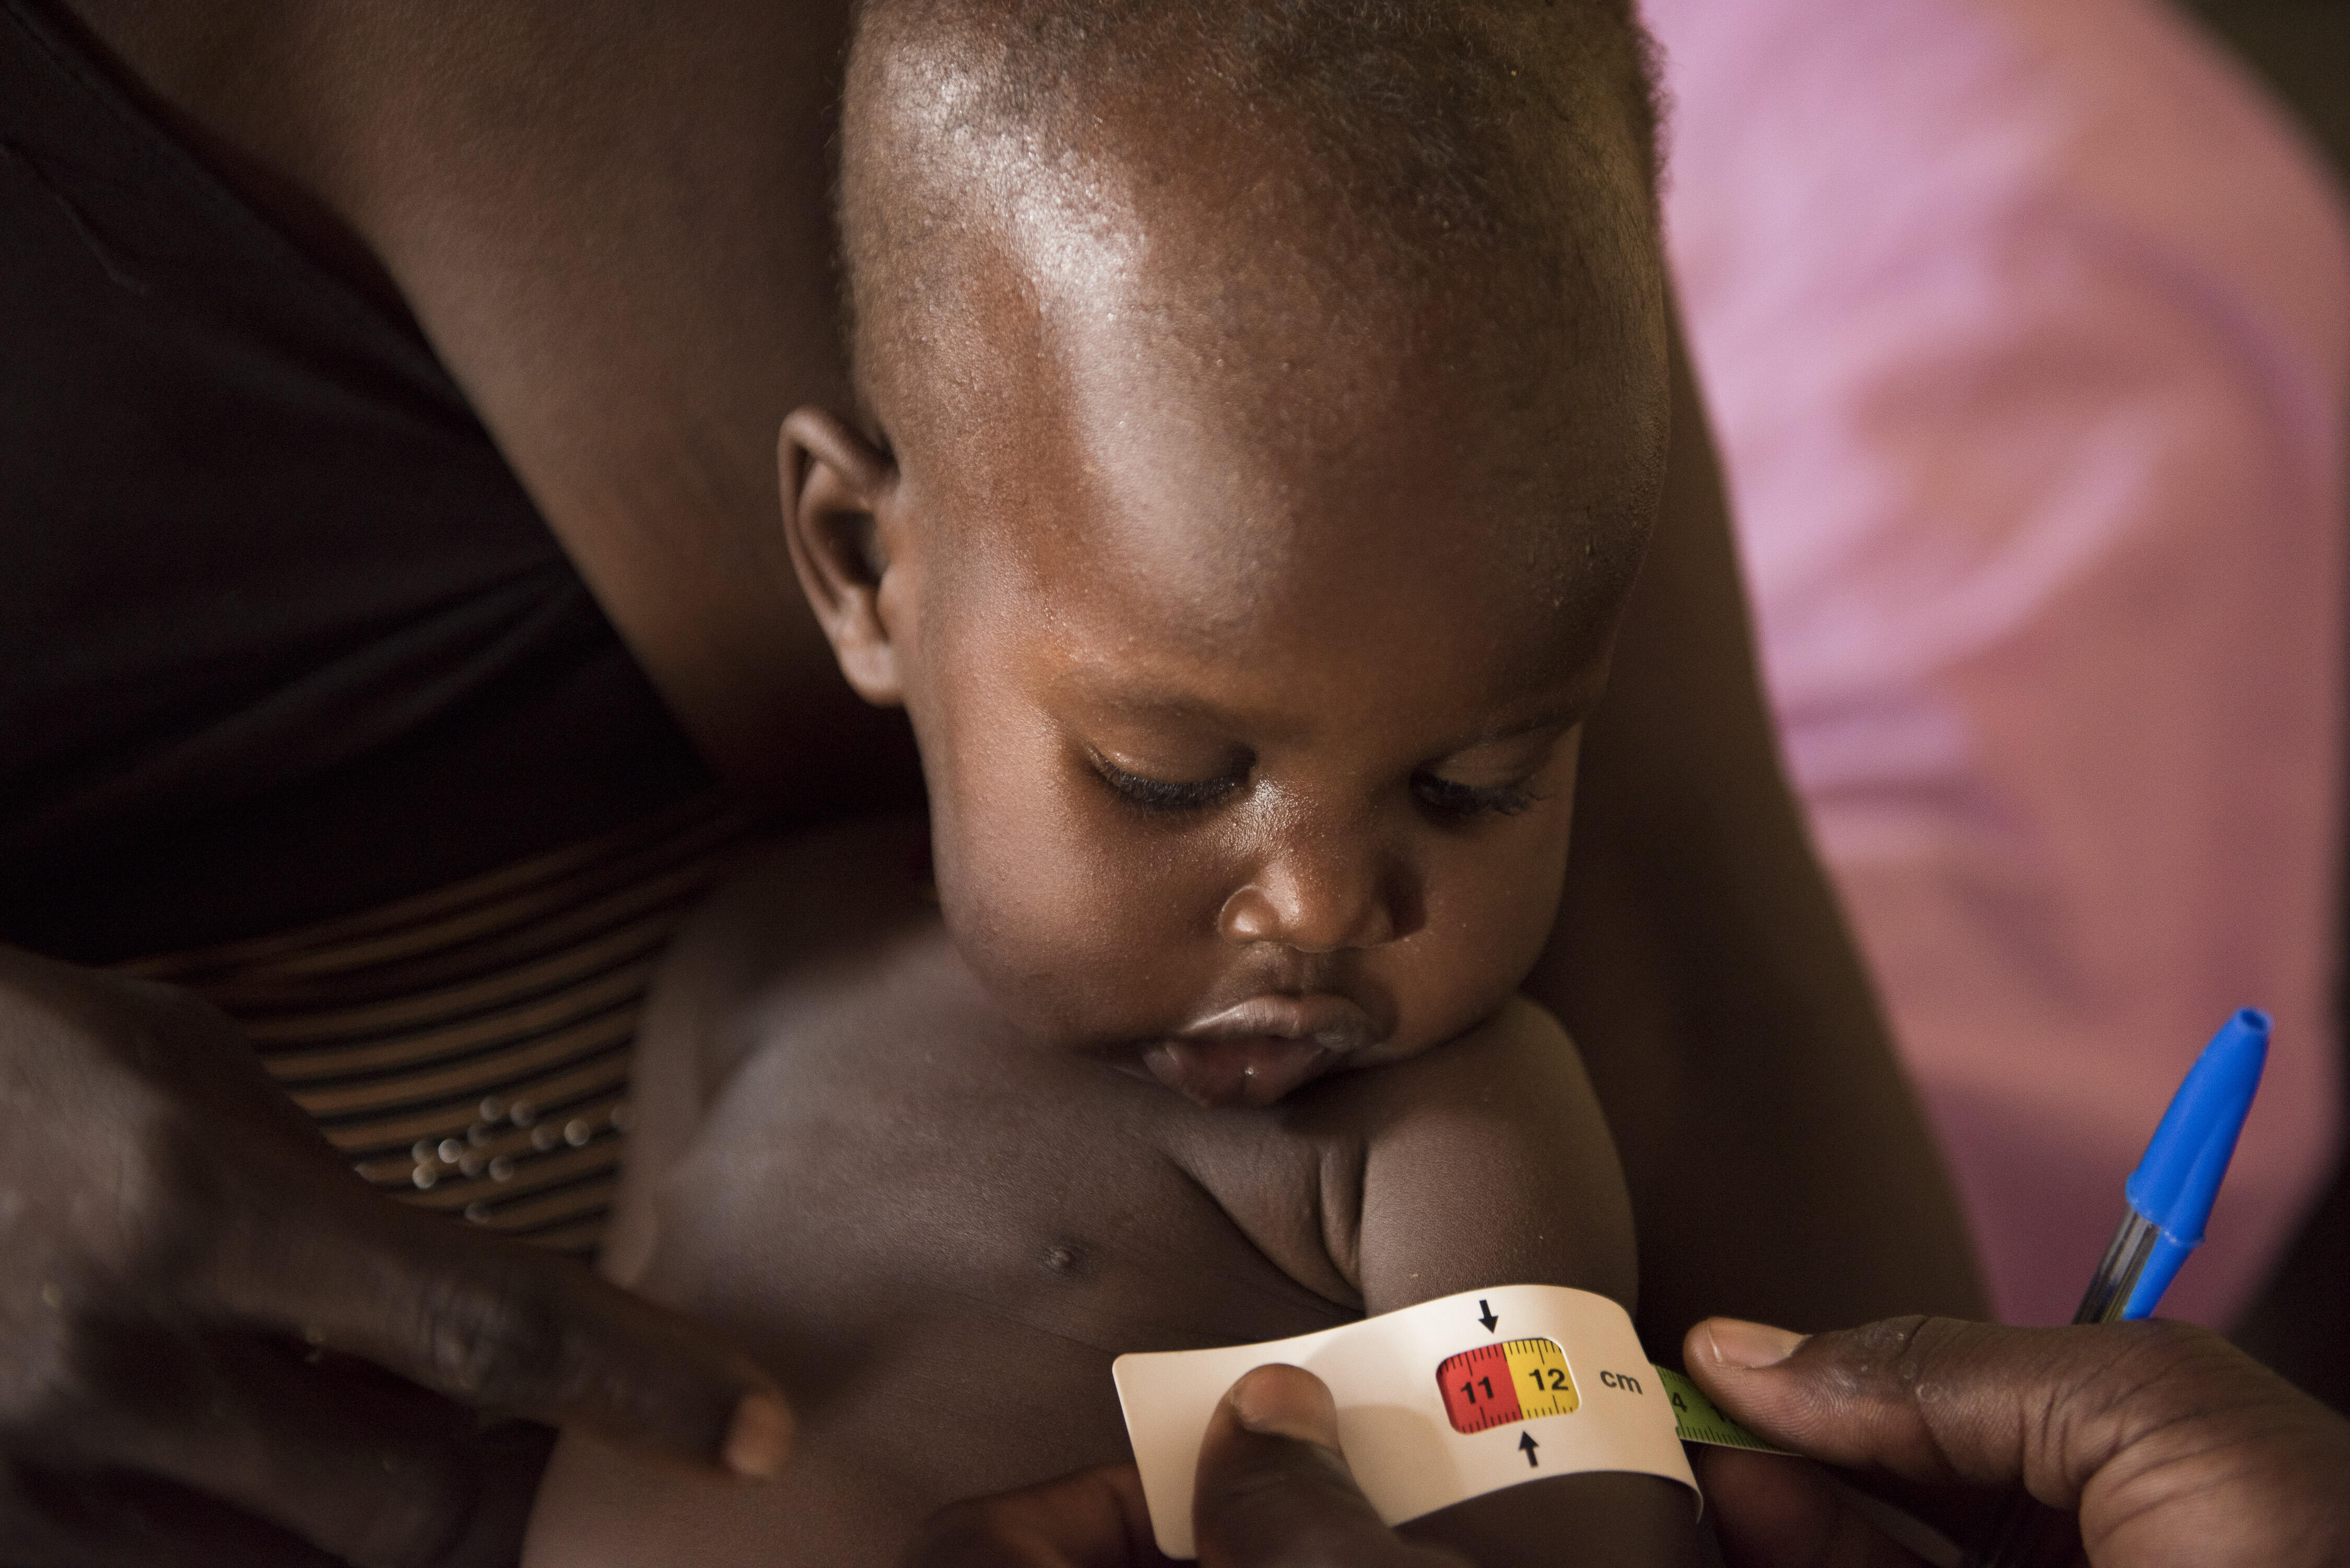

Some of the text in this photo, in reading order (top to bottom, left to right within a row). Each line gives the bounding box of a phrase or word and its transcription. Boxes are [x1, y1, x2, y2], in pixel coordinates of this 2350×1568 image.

[1460, 1369, 1643, 1404] 11 12 cm
